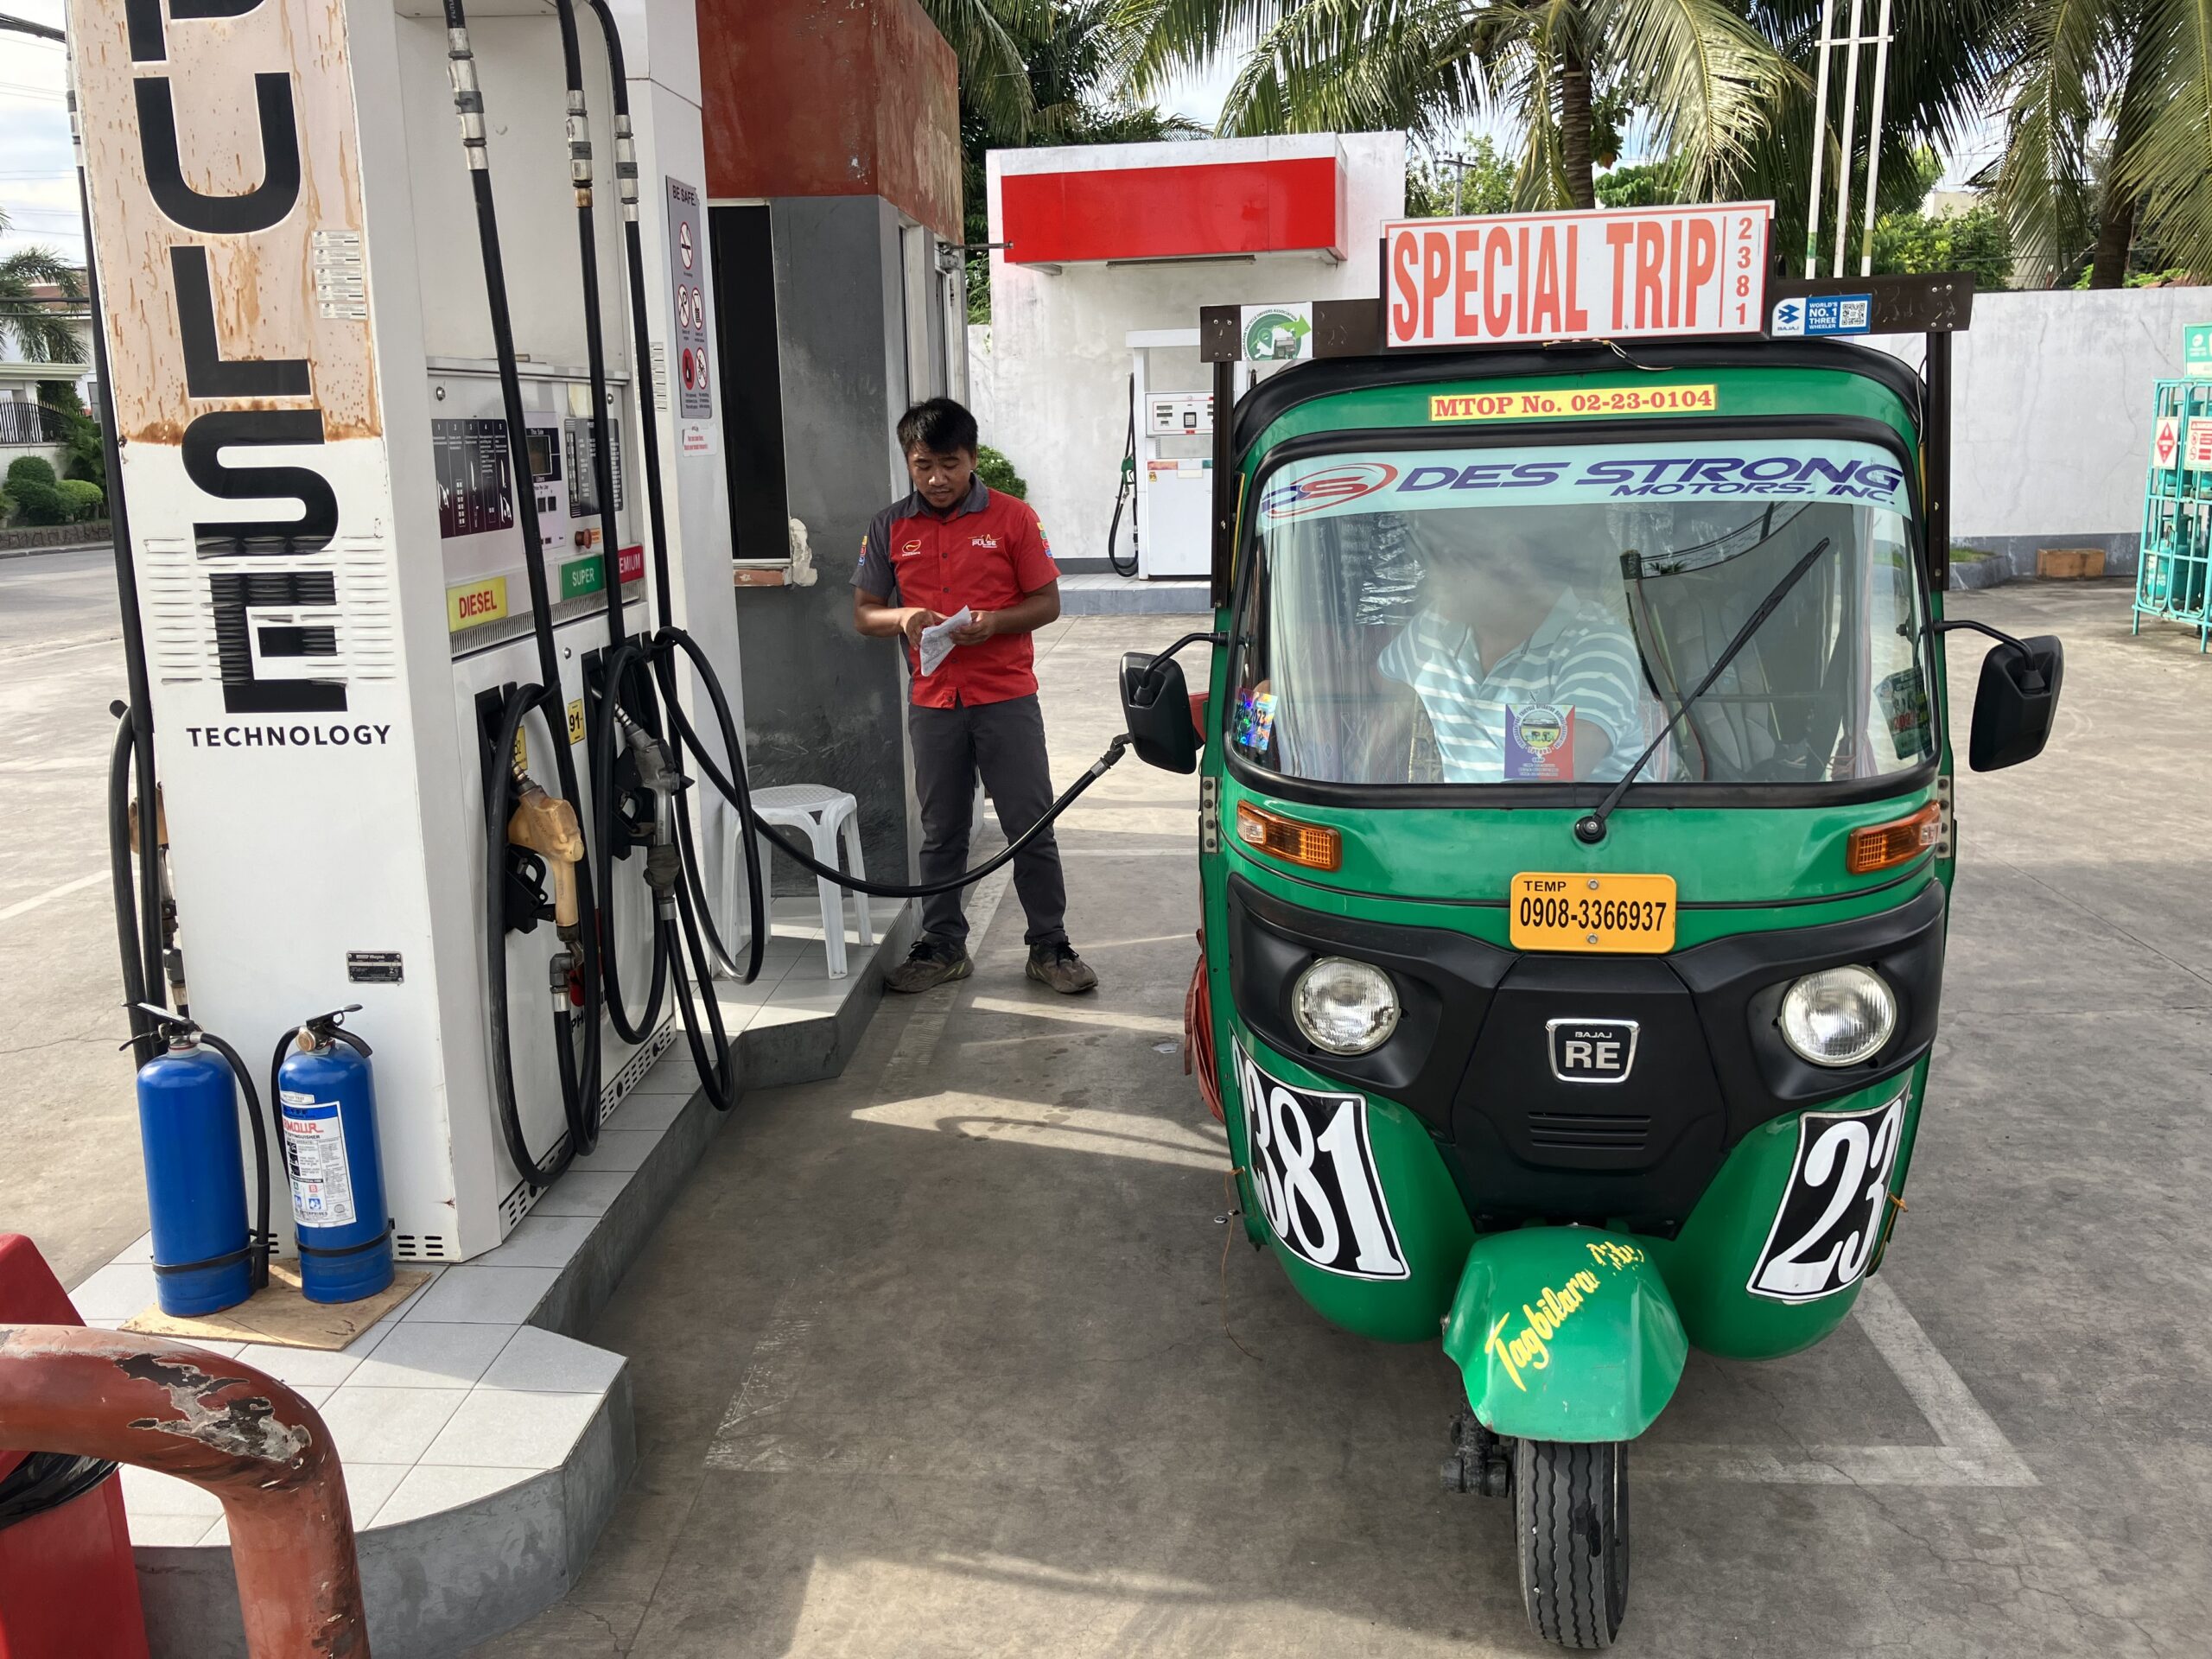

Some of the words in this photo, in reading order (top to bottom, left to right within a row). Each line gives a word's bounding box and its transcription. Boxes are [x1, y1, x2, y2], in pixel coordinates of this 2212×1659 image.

[672, 184, 681, 200] BE
[1393, 225, 1588, 342] SPECIAL
[1606, 219, 1716, 330] TRIP
[1809, 308, 1829, 317] NO.
[1833, 308, 1837, 316] 1
[1434, 397, 1513, 416] MTOP
[1522, 395, 1562, 413] No.
[1571, 390, 1712, 411] 02-23-0104
[1395, 462, 1572, 492] DES
[1573, 457, 1904, 493] STRONG
[1825, 484, 1895, 505] INC.
[619, 553, 641, 574] EMIUM
[572, 567, 595, 587] SUPER
[459, 590, 498, 619] DIESEL
[569, 711, 581, 733] 91
[186, 725, 391, 747] TECHNOLOGY
[1523, 880, 1567, 892] TEMP
[1520, 897, 1667, 931] 0908-3366937
[1565, 1040, 1621, 1069] RE
[283, 1118, 324, 1134] RMOUR
